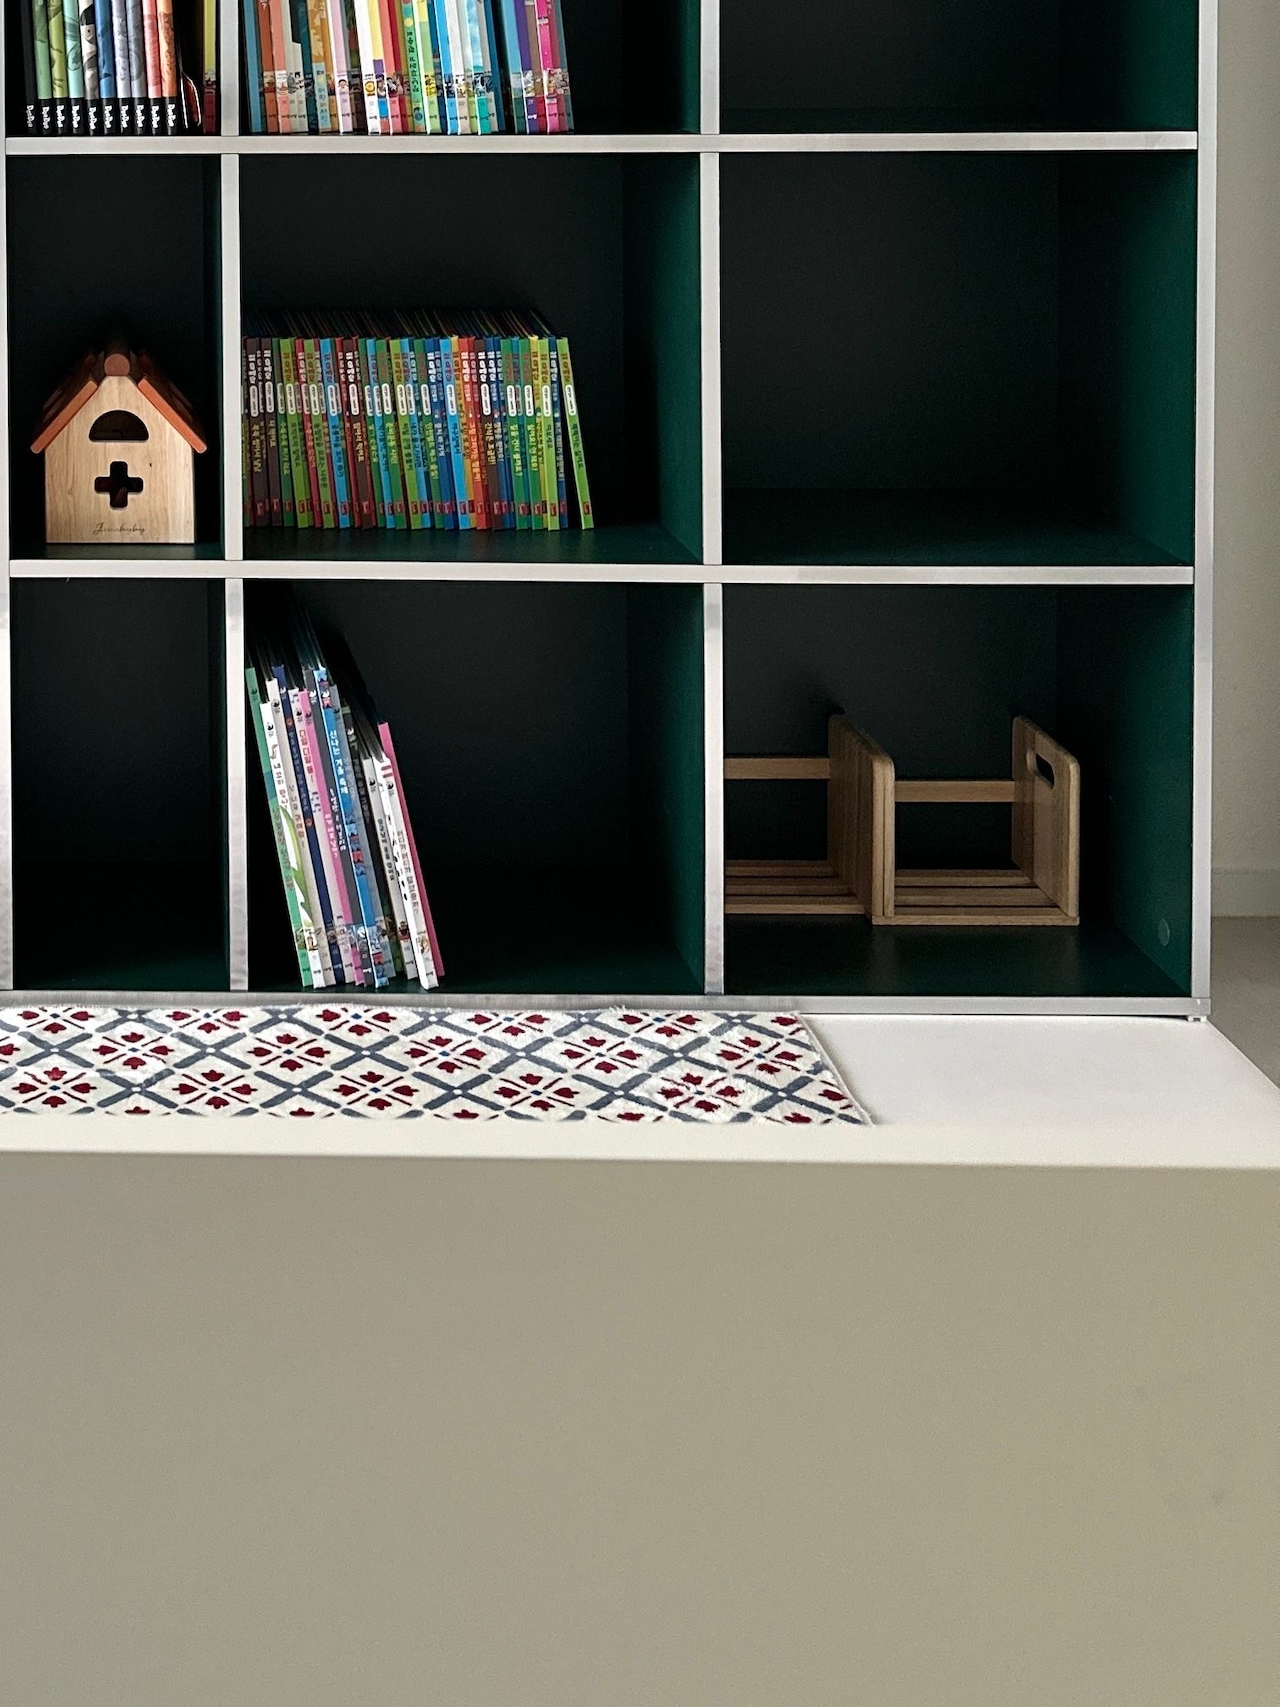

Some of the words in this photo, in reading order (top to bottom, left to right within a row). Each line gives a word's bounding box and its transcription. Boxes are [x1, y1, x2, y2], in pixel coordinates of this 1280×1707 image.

[467, 422, 475, 434] 그림
[484, 422, 493, 442] 간식은
[468, 436, 478, 459] 그리기는
